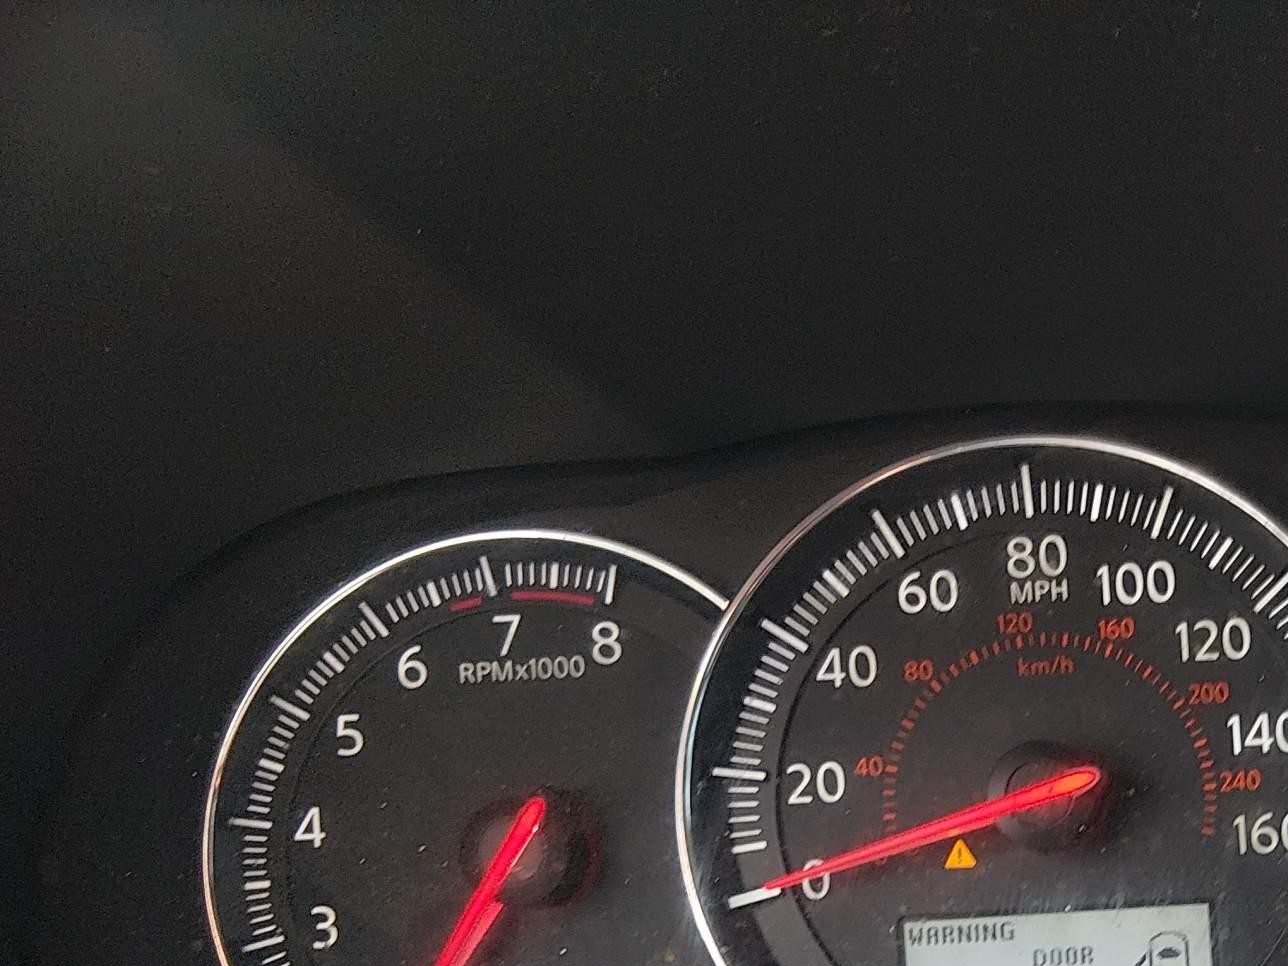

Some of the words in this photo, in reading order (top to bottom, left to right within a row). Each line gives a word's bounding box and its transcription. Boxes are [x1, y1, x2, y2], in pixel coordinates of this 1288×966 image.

[1006, 534, 1067, 579] 80
[897, 569, 959, 613] 60
[1010, 578, 1069, 605] MPH
[1096, 560, 1176, 606] 100
[492, 614, 522, 656] 7
[591, 620, 623, 665] 8
[996, 612, 1033, 634] 120
[1098, 617, 1134, 640] 160
[1175, 616, 1251, 662] 120
[398, 645, 428, 690] 6
[458, 656, 586, 685] RPMx1000
[816, 645, 877, 688] 40
[903, 659, 935, 681] 80
[1016, 655, 1074, 678] km/h
[1189, 682, 1229, 704] 200
[335, 713, 365, 756] 5
[787, 761, 845, 805] 20
[853, 756, 883, 778] 40
[1220, 769, 1261, 792] 240
[294, 807, 326, 848] 4
[802, 859, 831, 900] 0
[310, 906, 337, 950] 3
[908, 921, 1016, 946] WARNING
